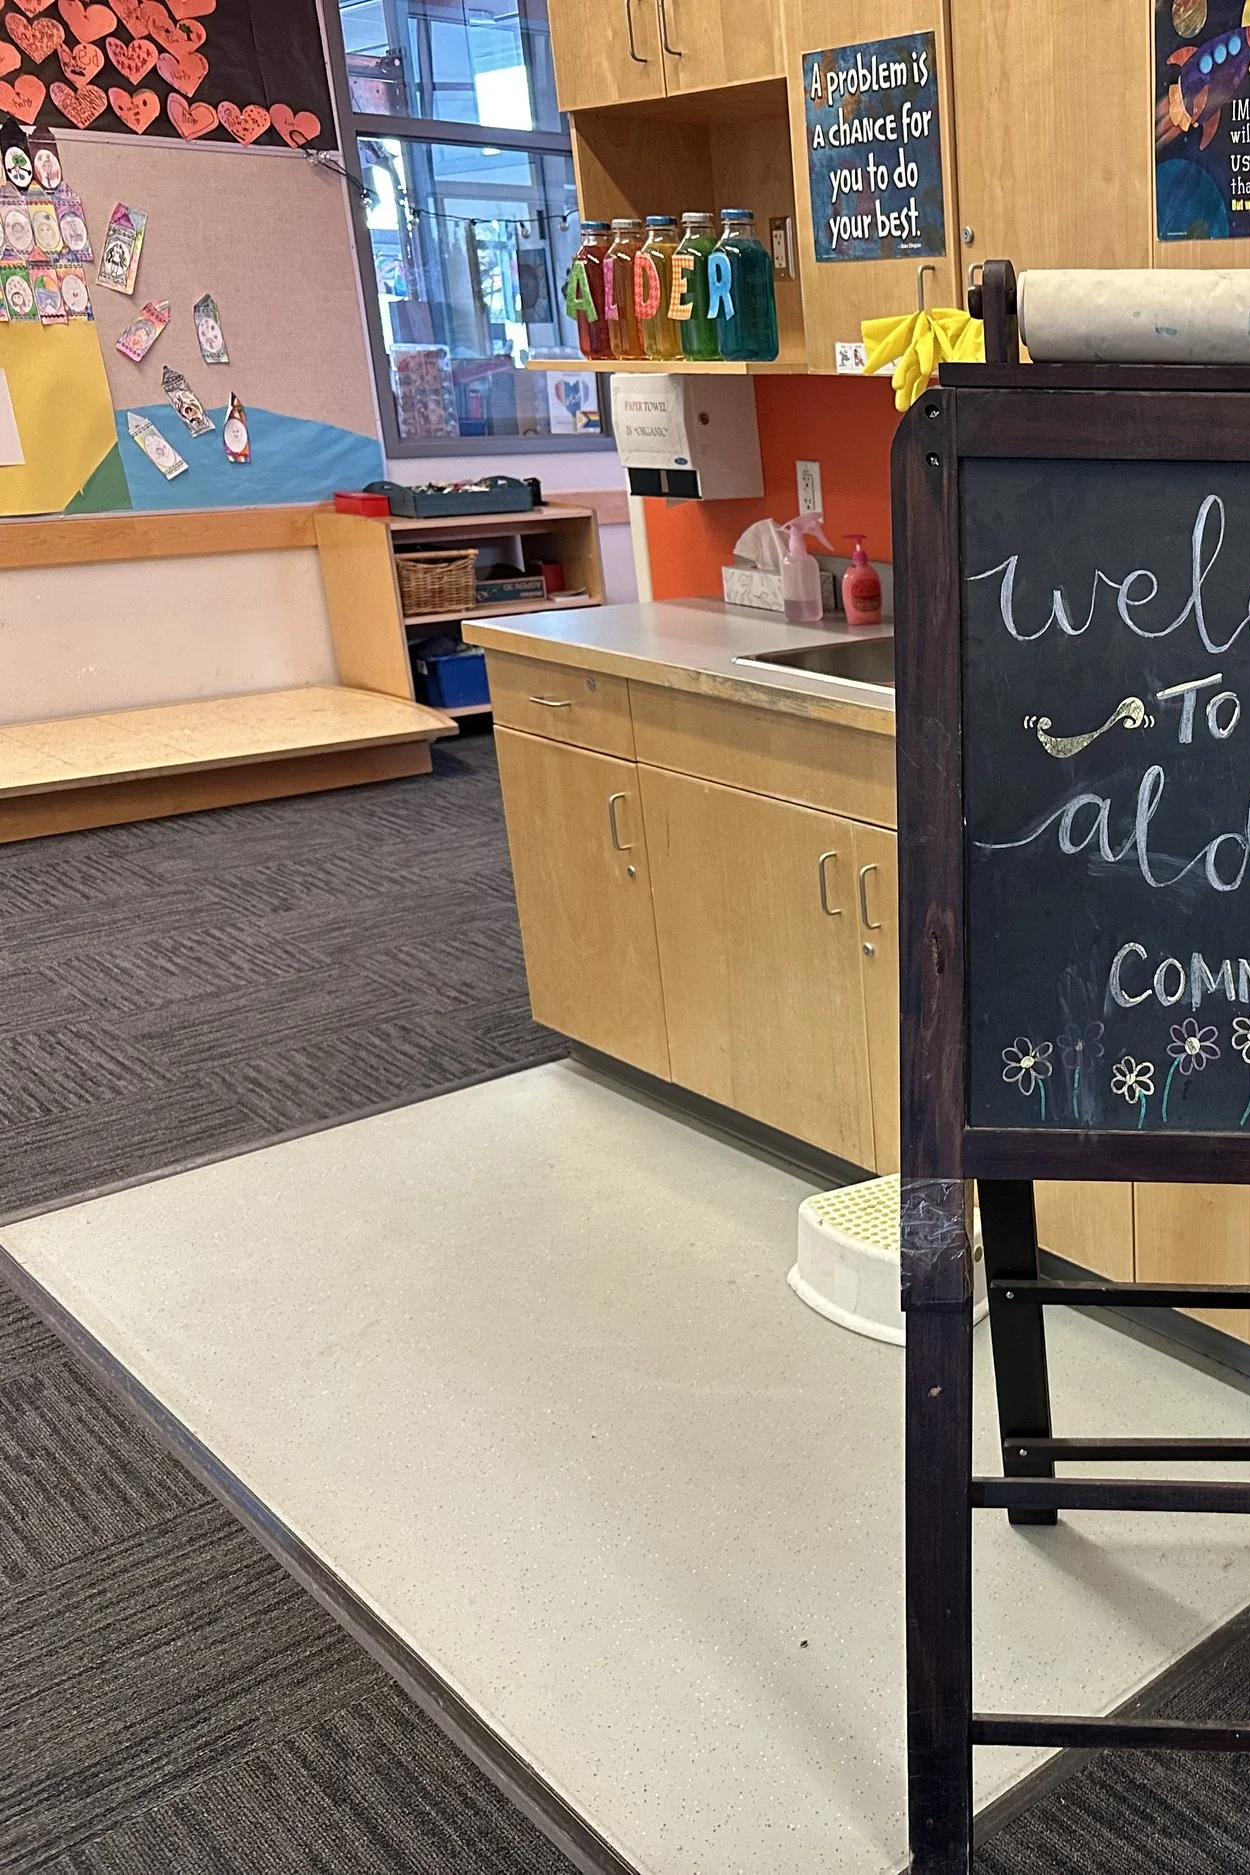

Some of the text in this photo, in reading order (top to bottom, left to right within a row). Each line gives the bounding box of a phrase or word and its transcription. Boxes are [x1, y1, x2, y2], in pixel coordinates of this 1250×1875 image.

[810, 62, 823, 100] A
[911, 51, 929, 88] is
[901, 101, 932, 144] for
[829, 147, 919, 204] you to do
[1230, 154, 1250, 172] us
[1231, 199, 1244, 211] But
[828, 214, 872, 250] your
[624, 401, 667, 412] PAPER TOWEL
[1157, 672, 1242, 744] TO
